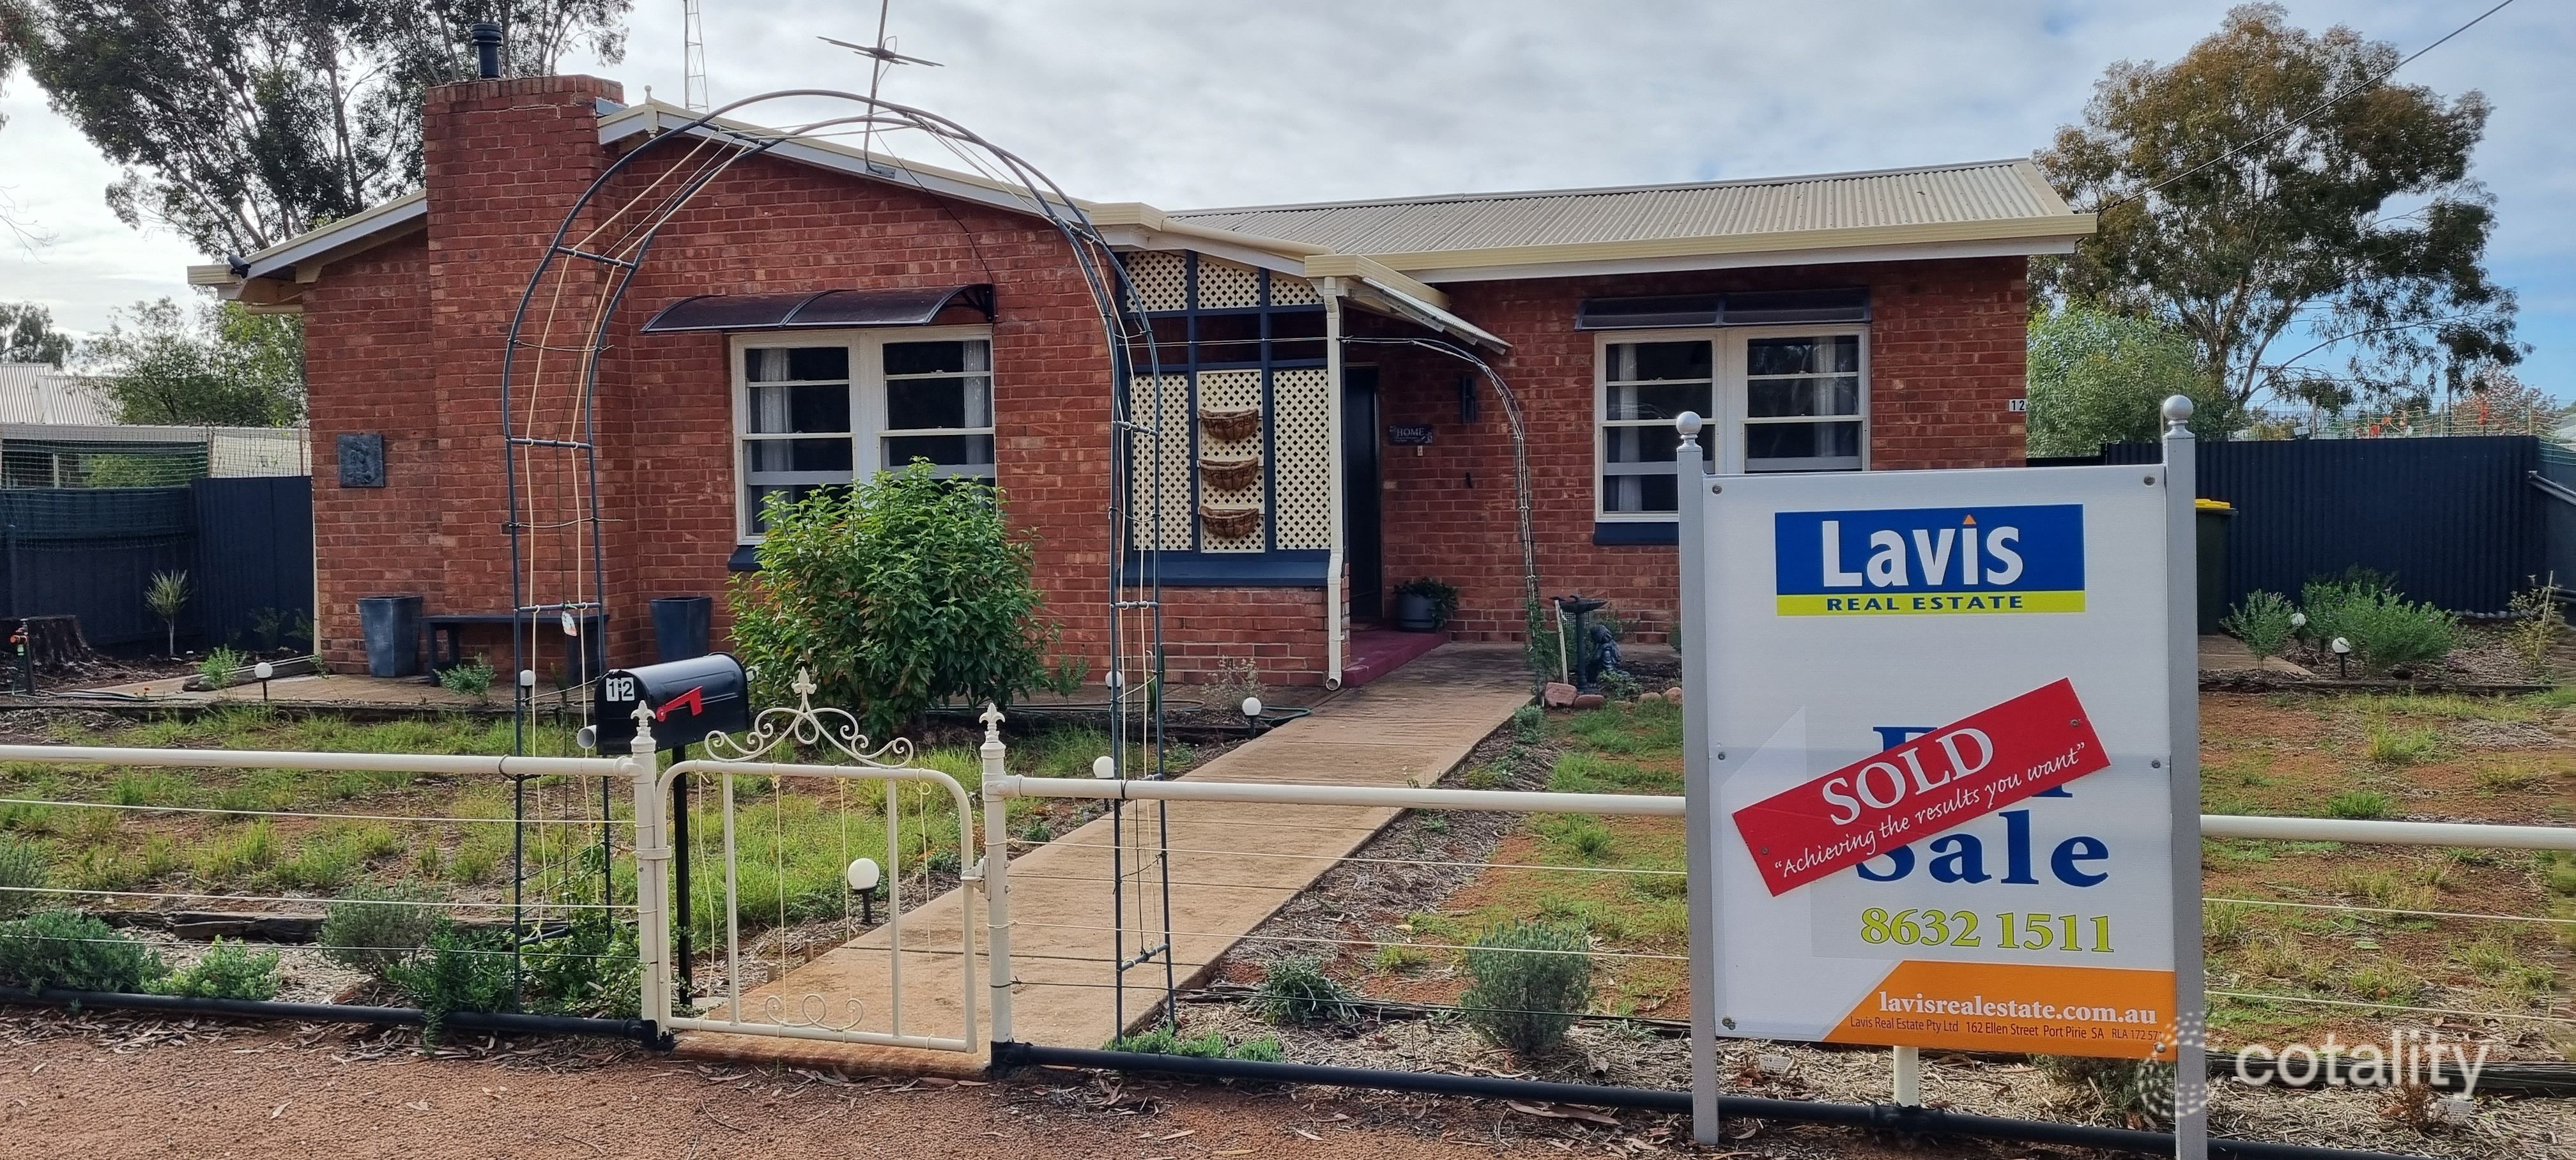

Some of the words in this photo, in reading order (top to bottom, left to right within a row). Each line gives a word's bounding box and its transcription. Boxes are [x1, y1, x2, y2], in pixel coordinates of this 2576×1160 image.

[2011, 400, 2025, 411] 12
[1396, 427, 1425, 436] HOME
[1821, 514, 2023, 586] Lavis
[1827, 597, 1899, 611] REAL
[1913, 595, 2023, 609] ESTATE
[608, 680, 632, 698] 12
[1822, 728, 1993, 825] SOLD
[1879, 814, 1910, 838] the
[1915, 788, 1980, 824] results
[1984, 774, 2022, 809] you
[1860, 908, 1981, 947] 8632
[1997, 912, 2114, 952] 1511
[1880, 991, 2157, 1024] lavisrealestate.com.au
[1850, 1016, 1873, 1028] Lavis
[1875, 1017, 1894, 1029] Real
[1897, 1018, 1924, 1030] Estate
[1927, 1019, 1942, 1034] Pty
[1943, 1021, 1958, 1032] Ltd
[1966, 1022, 1983, 1033] 162
[1986, 1023, 2008, 1034] Ellen
[2011, 1024, 2038, 1036] Street
[2044, 1025, 2063, 1037] Port
[2066, 1027, 2087, 1039] Pirie
[2091, 1027, 2104, 1039] SA
[2112, 1028, 2128, 1039] RLA
[2131, 1030, 2146, 1039] 172
